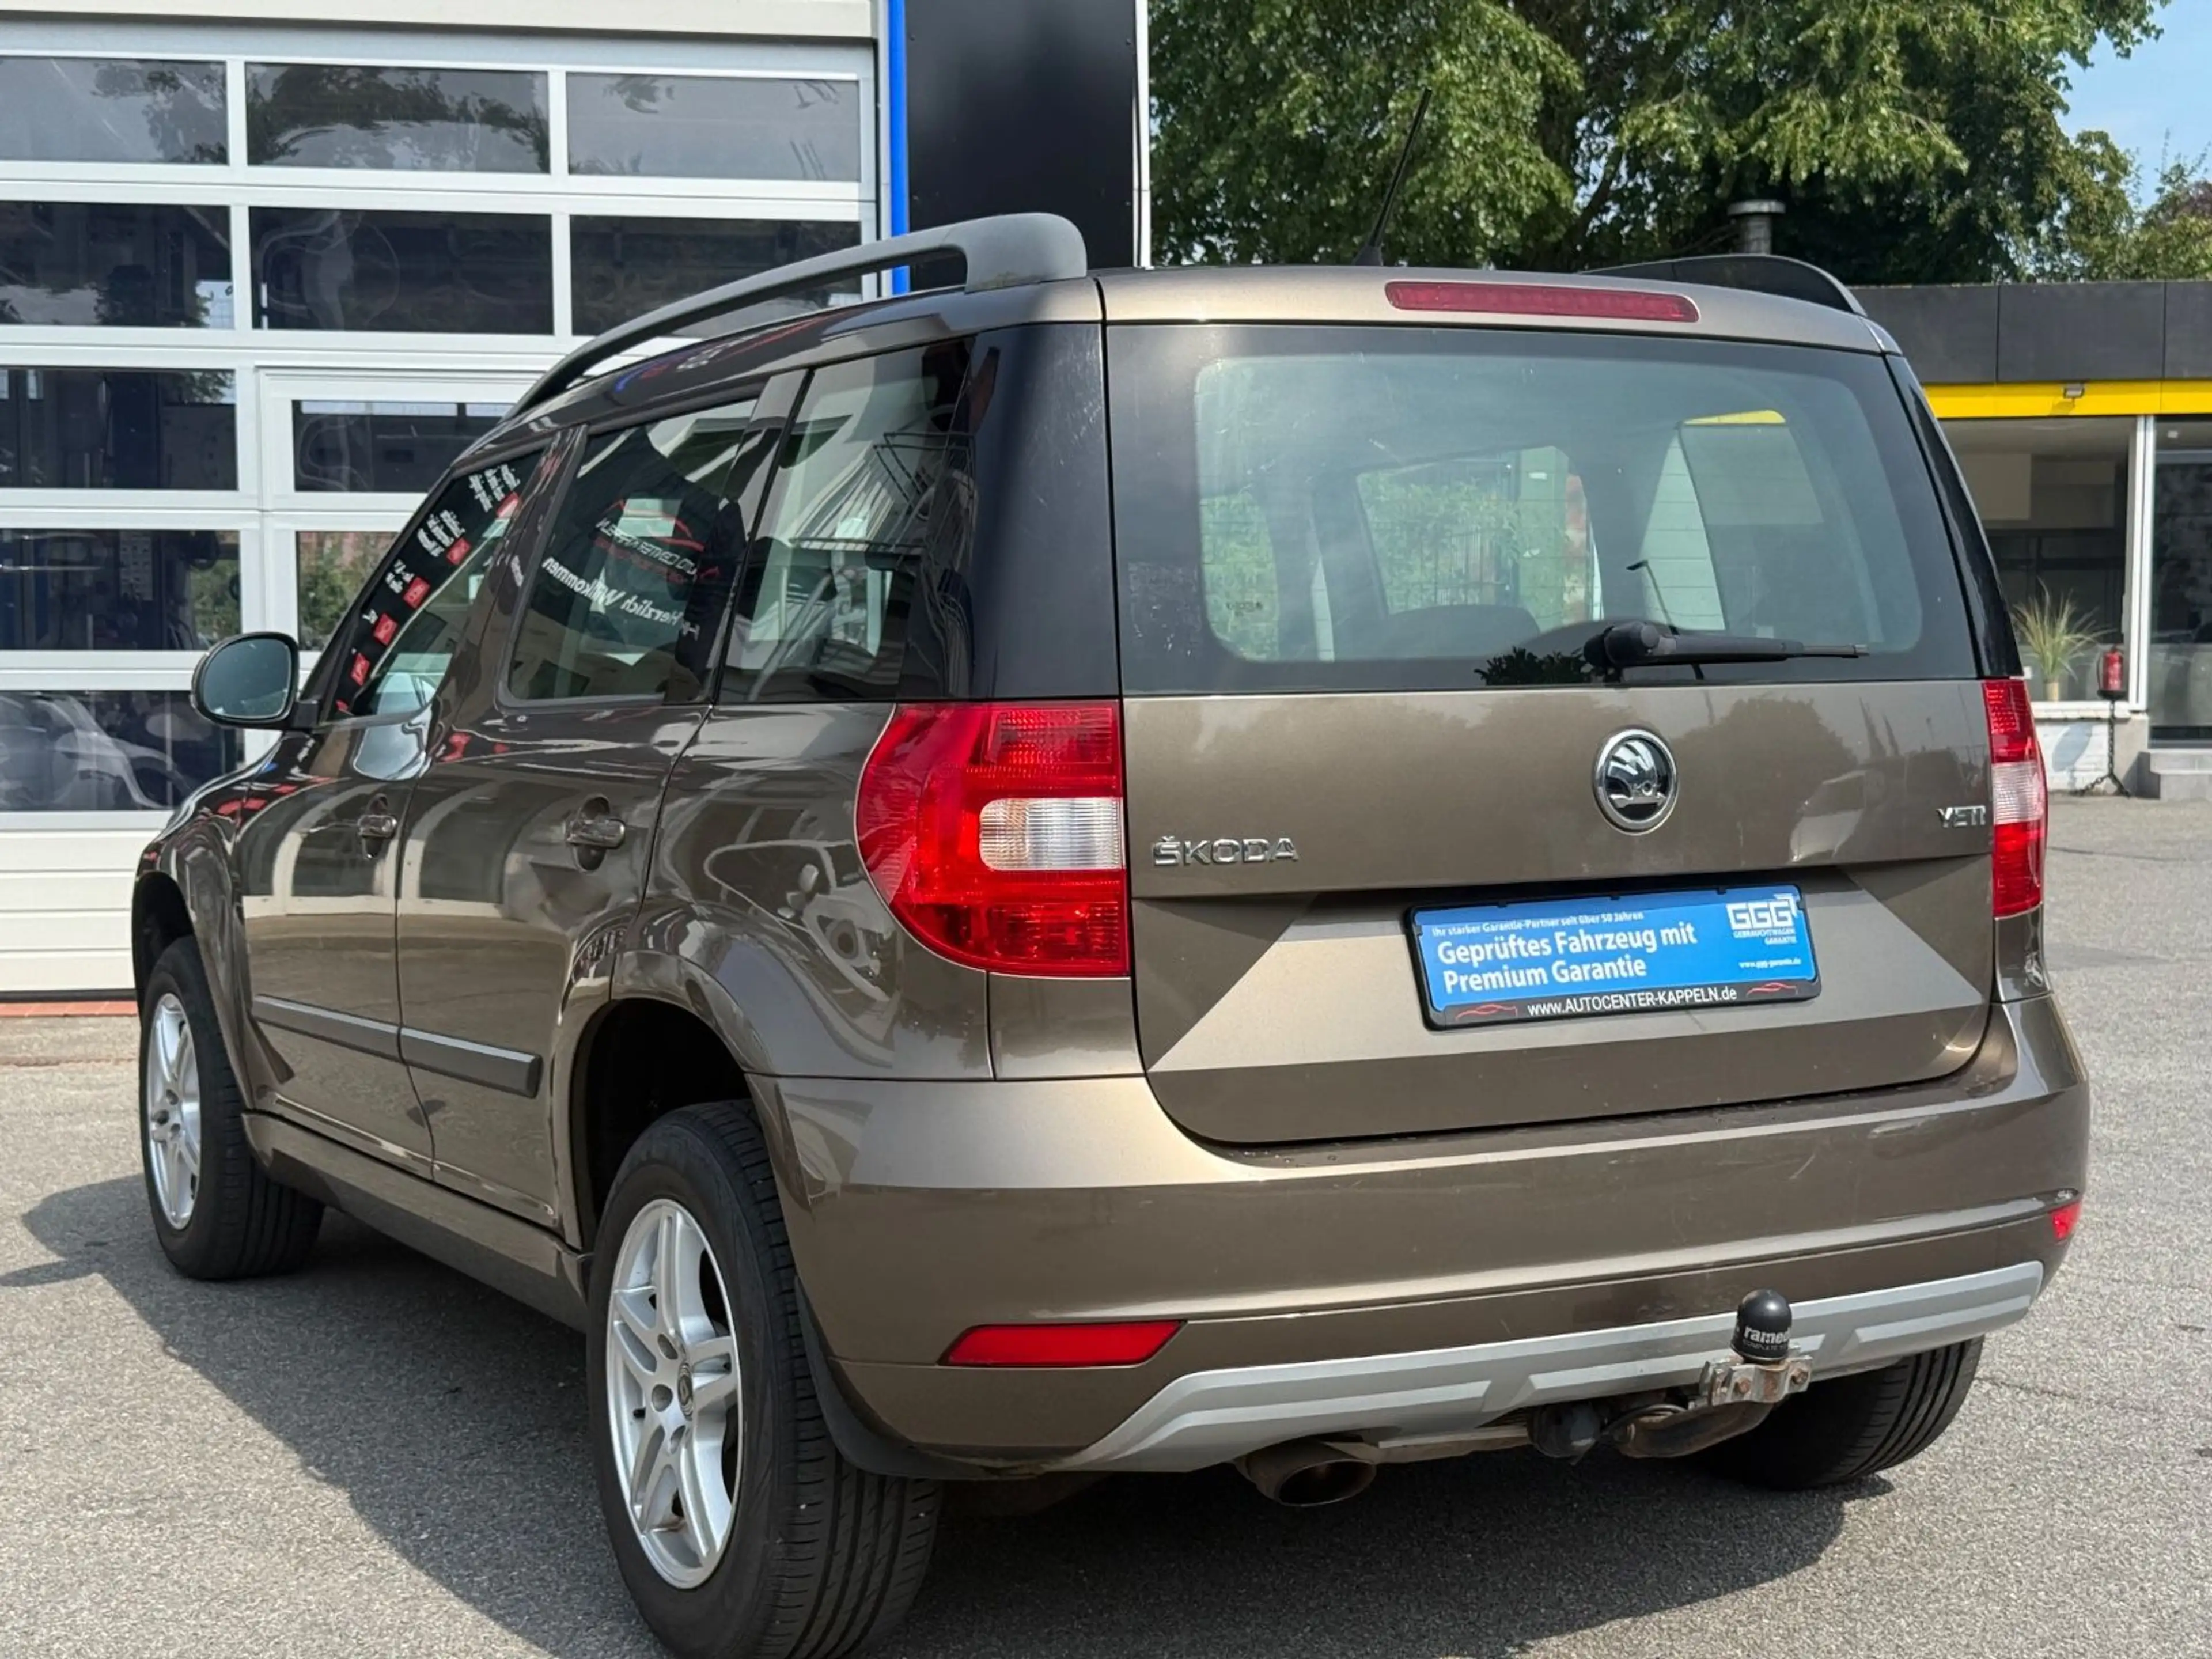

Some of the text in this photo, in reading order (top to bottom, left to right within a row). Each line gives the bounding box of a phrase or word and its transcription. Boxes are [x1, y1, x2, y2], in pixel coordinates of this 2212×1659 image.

[1936, 805, 1986, 828] YETI
[1152, 835, 1298, 866] ŠKODA
[1726, 897, 1795, 930] GGG
[1438, 924, 1698, 968] Geprüftes Fahrzeug mit
[1444, 955, 1646, 994] Premium Garantie
[1528, 986, 1737, 1016] www.AUTOCENTER-KAPPELN.de
